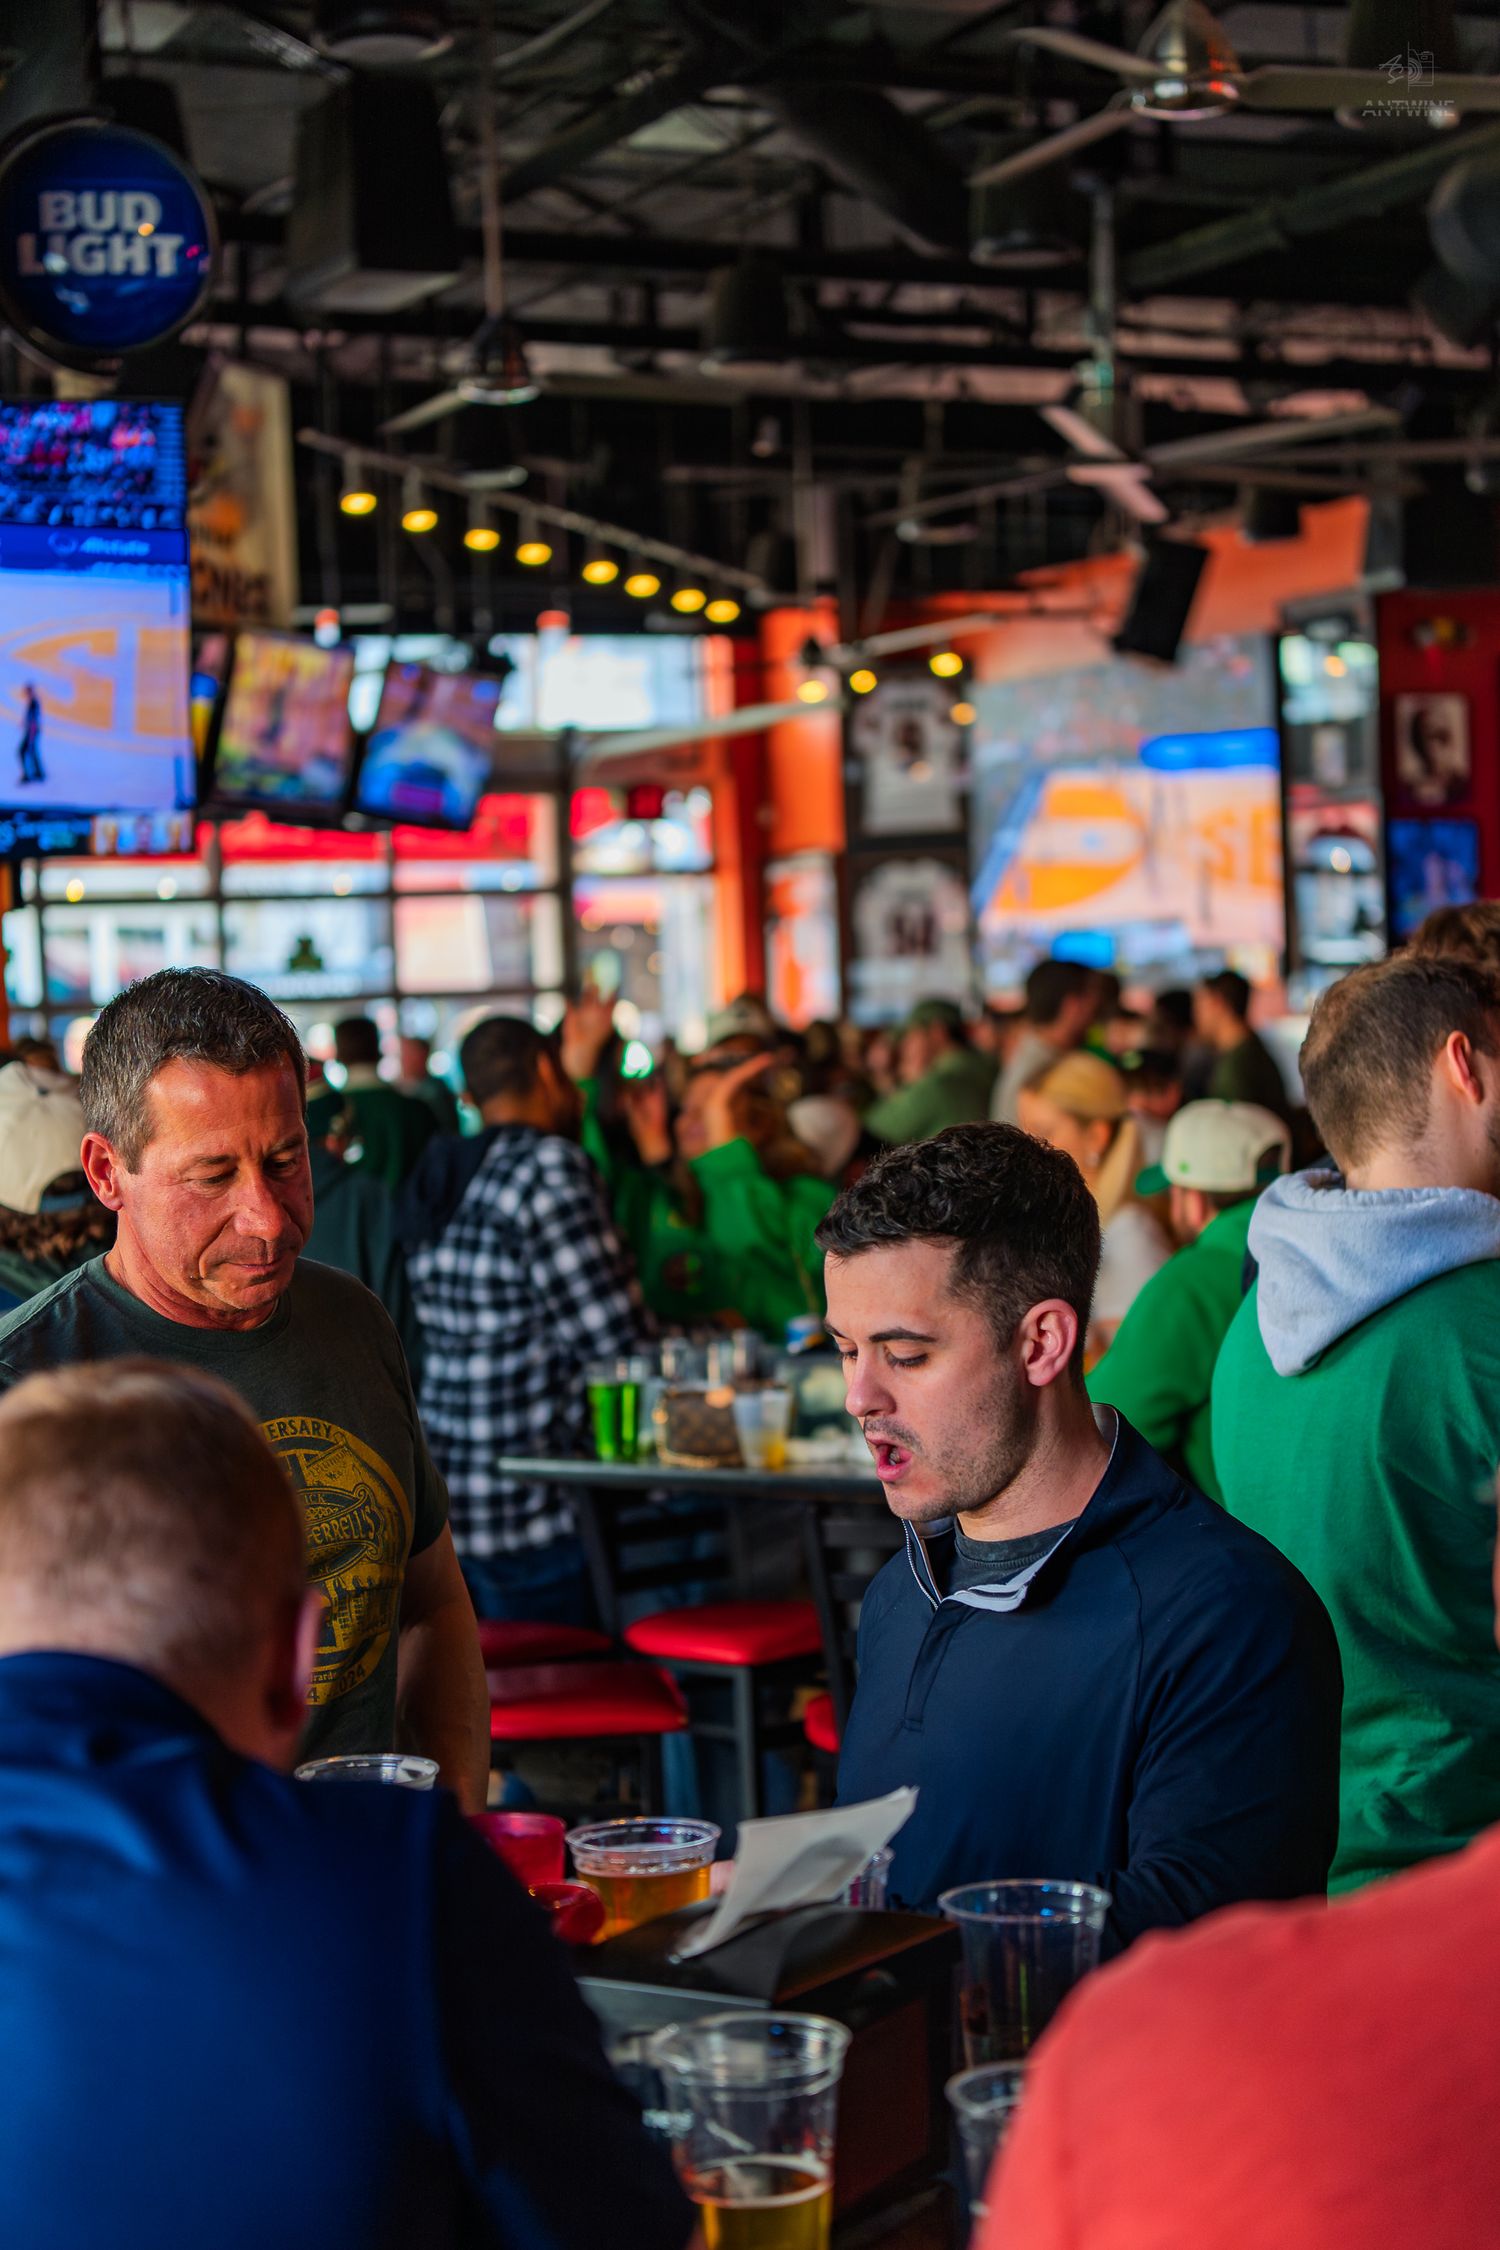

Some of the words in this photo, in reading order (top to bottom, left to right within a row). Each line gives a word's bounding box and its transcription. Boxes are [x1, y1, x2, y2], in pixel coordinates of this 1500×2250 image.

[38, 191, 163, 232] BUD
[16, 233, 185, 278] LIGHT
[267, 1419, 332, 1439] ERSARY
